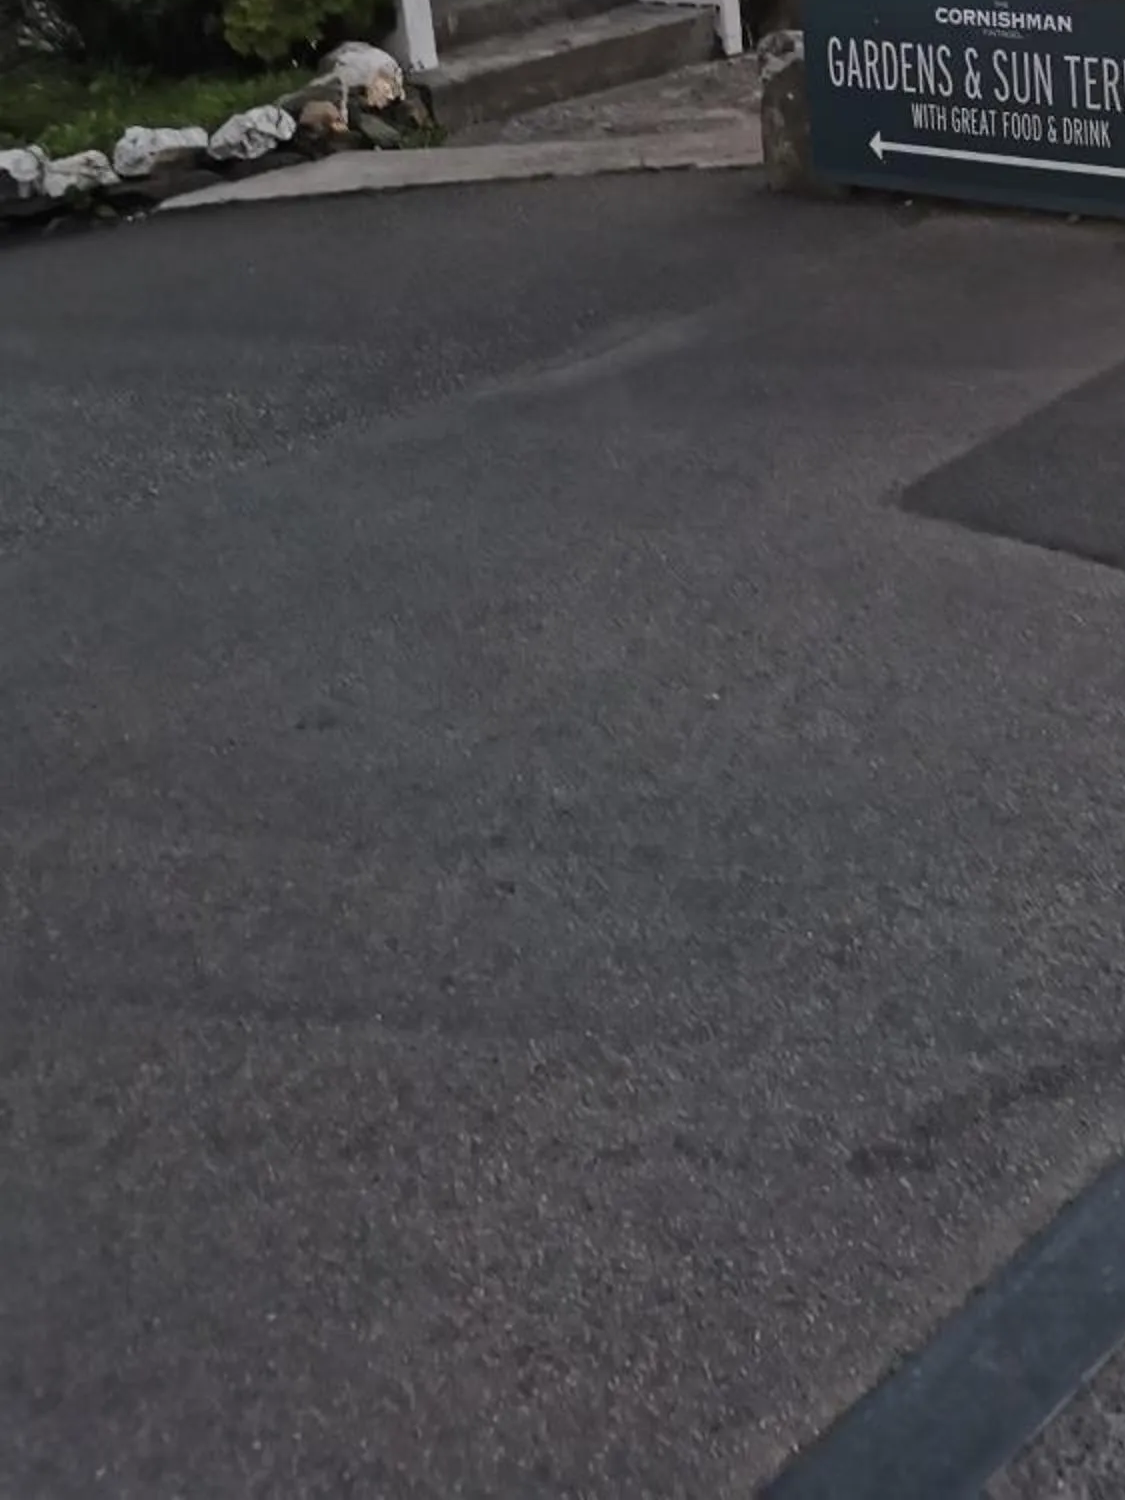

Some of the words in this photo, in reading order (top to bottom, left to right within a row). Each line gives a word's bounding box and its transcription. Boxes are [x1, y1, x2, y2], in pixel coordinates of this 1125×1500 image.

[935, 7, 1074, 33] CORNISHMAN
[827, 35, 954, 98] GARDENS
[965, 47, 983, 100] &
[993, 48, 1054, 107] SUN
[911, 103, 947, 133] WITH
[951, 107, 998, 139] GREAT
[1002, 111, 1041, 142] FOOD
[1047, 115, 1057, 144] &
[1062, 117, 1112, 149] DRINK
